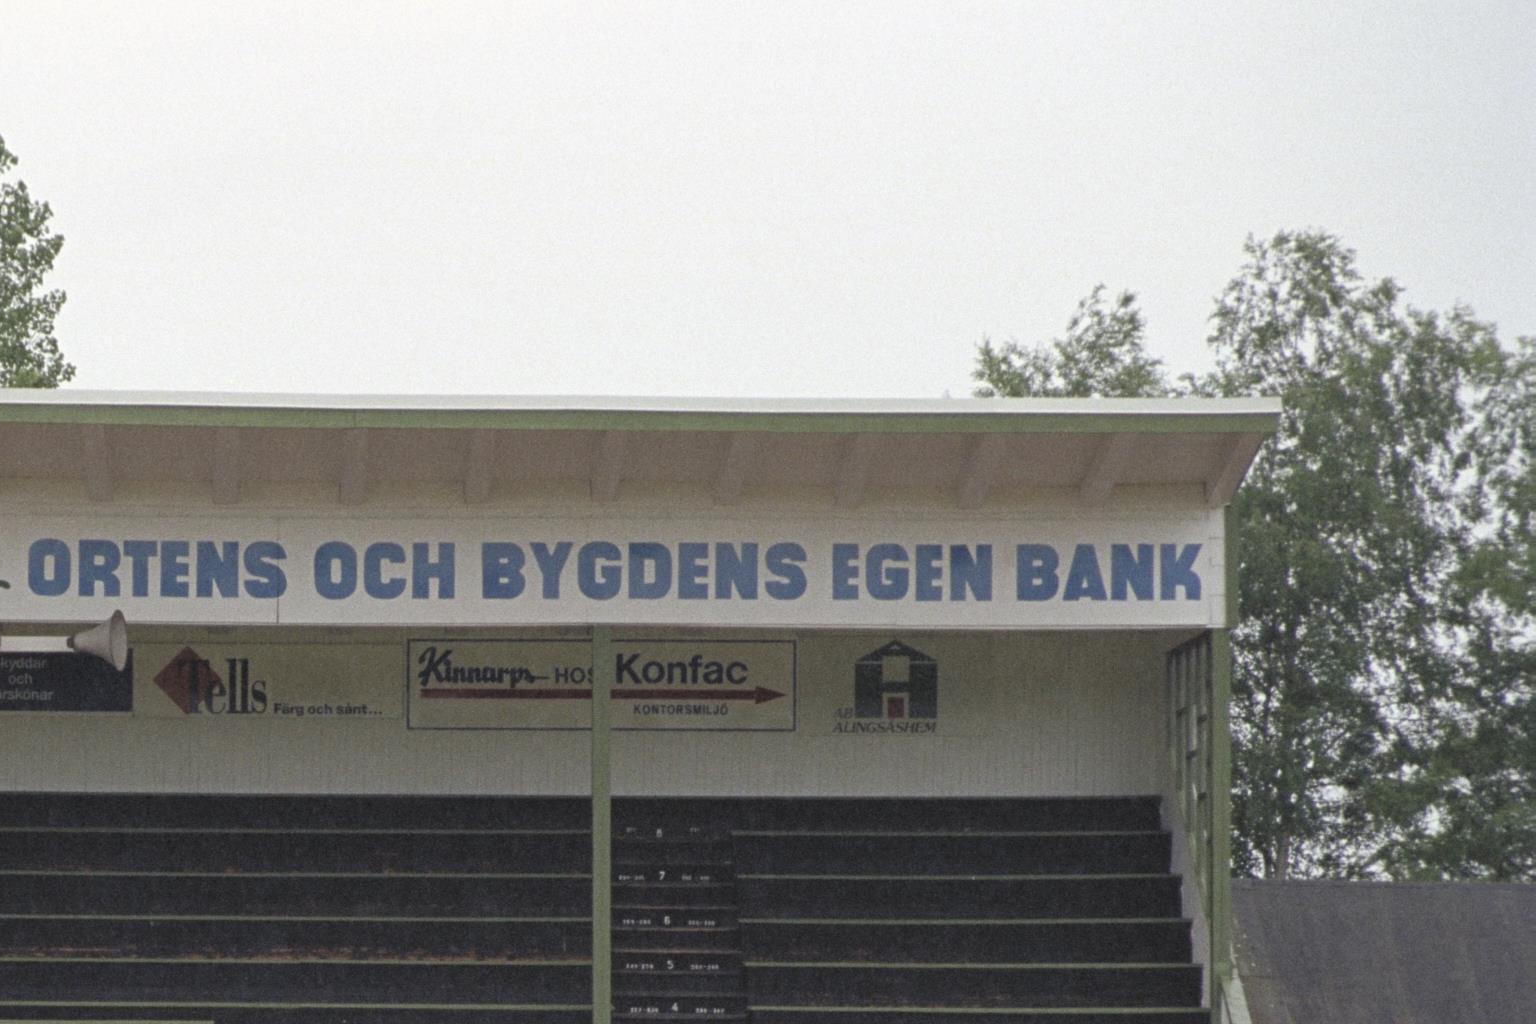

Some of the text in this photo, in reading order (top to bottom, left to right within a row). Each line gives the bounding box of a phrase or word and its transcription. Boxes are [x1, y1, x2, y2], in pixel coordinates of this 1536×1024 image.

[27, 538, 1202, 601] ORTENS OCH BYGDENS EGEN BANK
[8, 673, 33, 684] och
[616, 653, 748, 684] Konfac
[176, 656, 268, 714] Tells
[273, 702, 305, 717] Färg
[307, 703, 333, 715] och
[633, 704, 729, 716] KONTORSMILJÖ
